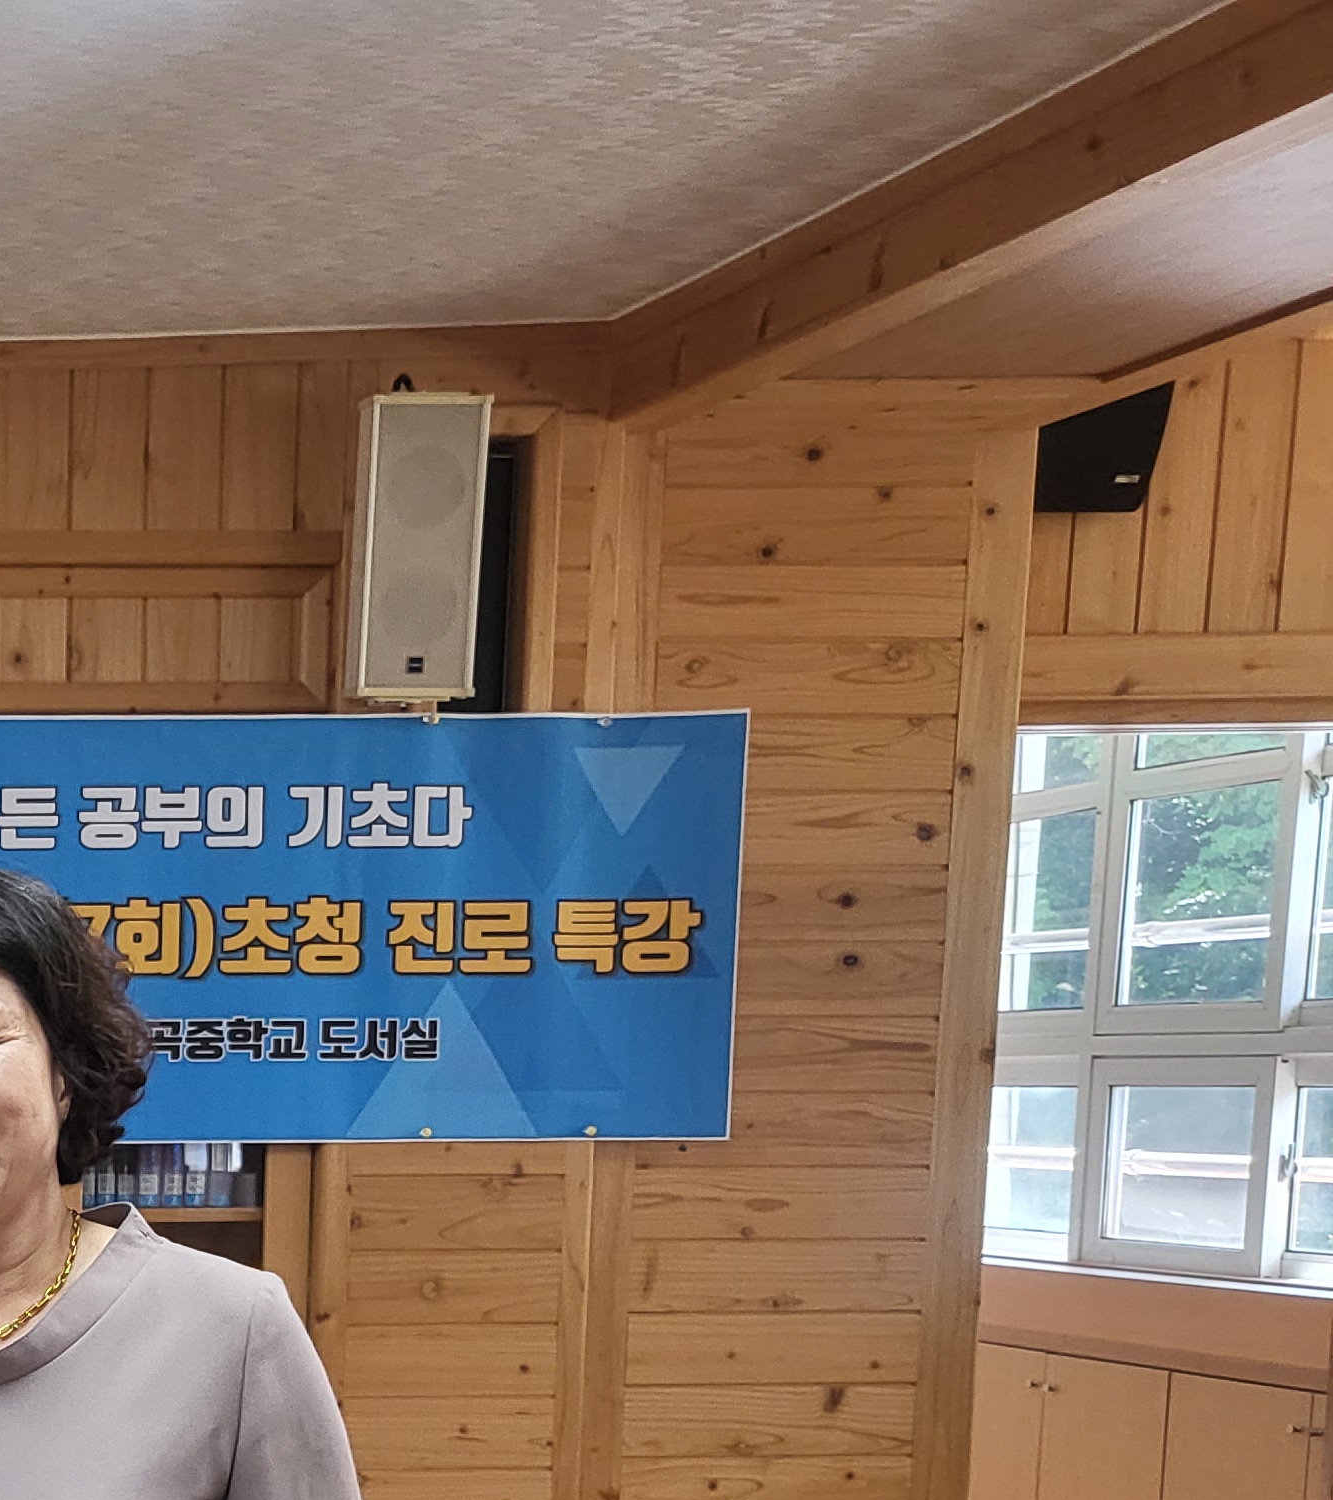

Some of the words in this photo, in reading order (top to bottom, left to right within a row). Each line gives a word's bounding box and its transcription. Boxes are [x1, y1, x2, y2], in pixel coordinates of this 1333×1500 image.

[76, 784, 266, 851] 공부의
[286, 781, 475, 849] 기초다
[387, 900, 533, 975] 진로
[552, 898, 703, 975] 특강
[318, 1018, 439, 1061] 도서실
